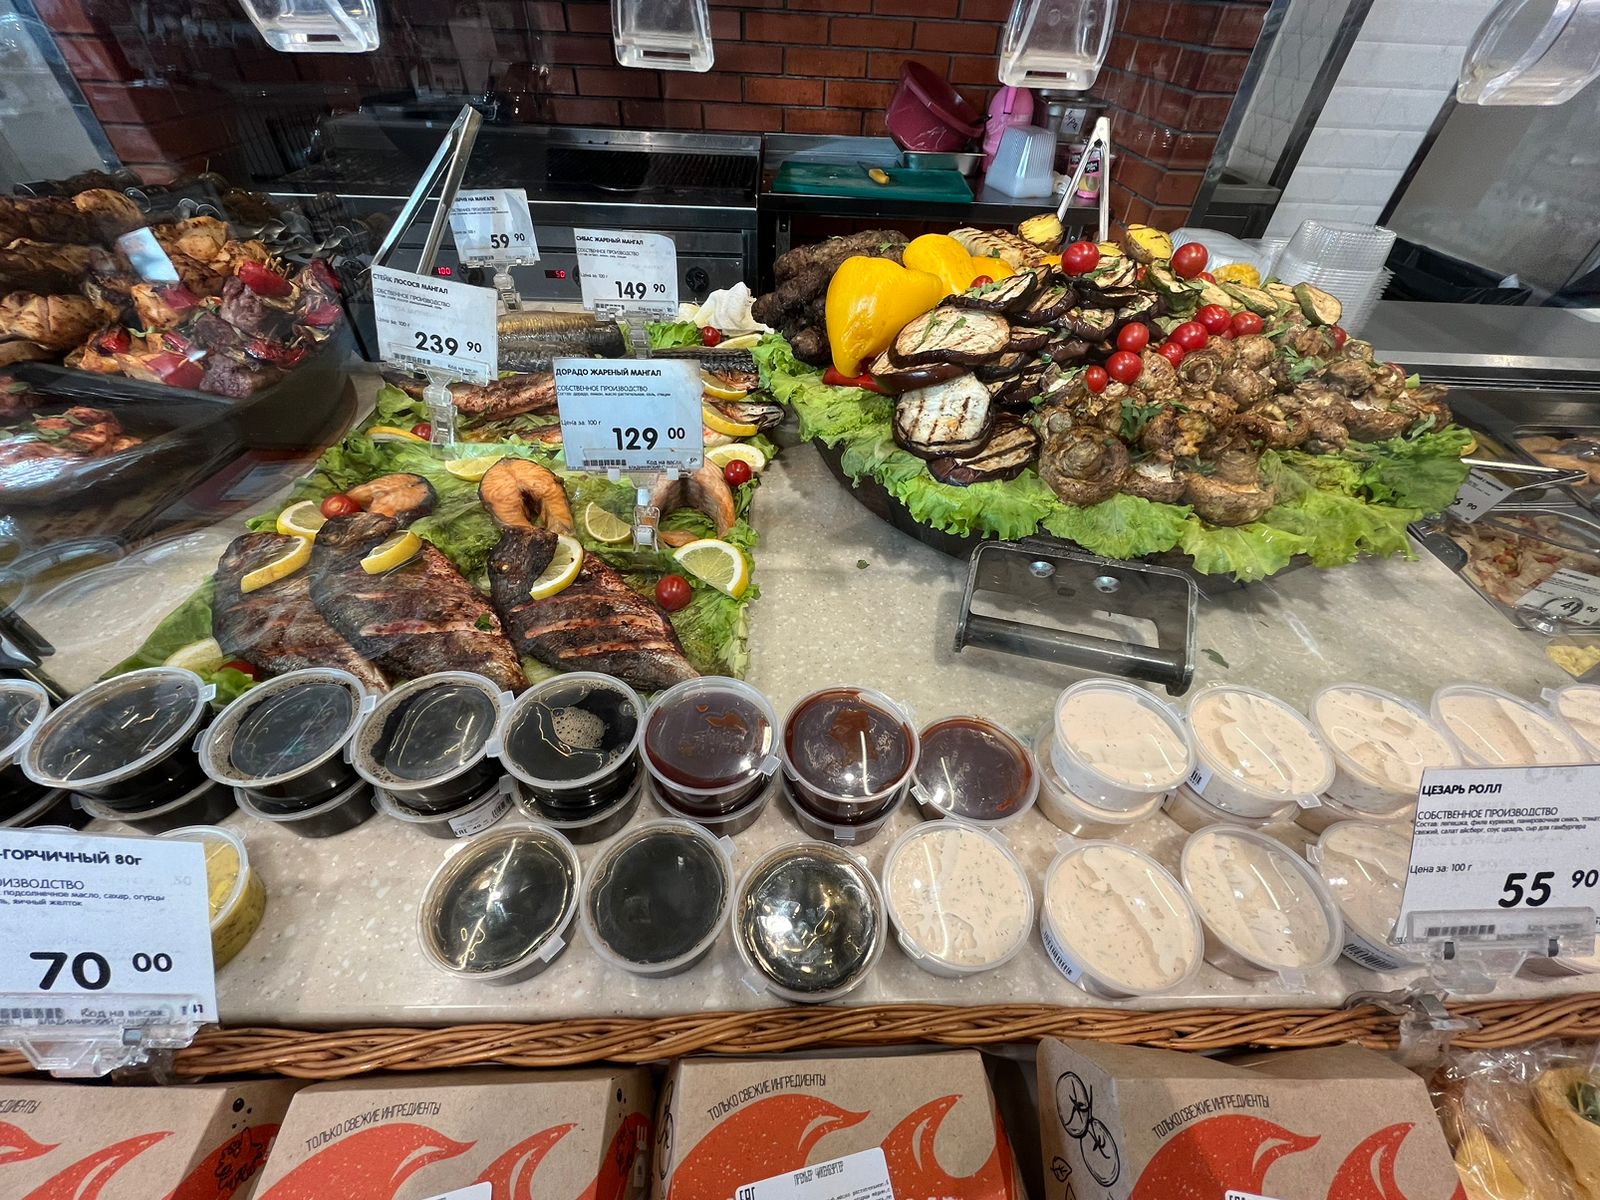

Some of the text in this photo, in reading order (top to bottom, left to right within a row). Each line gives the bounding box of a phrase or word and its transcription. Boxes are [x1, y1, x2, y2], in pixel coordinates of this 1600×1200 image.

[490, 233, 510, 249] 59
[514, 232, 526, 242] 90
[437, 267, 452, 276] 100
[373, 274, 449, 295] СТЕЙК ЛОСОСЯ МАНГАЛ
[615, 281, 647, 300] 149
[653, 283, 666, 293] 90
[415, 331, 459, 356] 239
[466, 341, 482, 353] 90
[556, 368, 662, 377] ДОРАДО ЖАРЕНЫЙ МАНГАЛ
[612, 427, 659, 451] 129
[668, 427, 685, 440] 00
[1422, 784, 1502, 796] ЦЕЗАРЬ РОЛЛ
[1418, 807, 1558, 820] СОБСТВЕННОЕ ПРОИЗВОДСТВО
[0, 849, 142, 866] -ГОРЧИЧНЫЙ 80г
[1410, 864, 1434, 873] Цена
[1436, 864, 1448, 872] за:
[1451, 863, 1466, 871] 100
[1571, 870, 1599, 888] 90
[1498, 871, 1555, 908] 55
[29, 952, 111, 990] 70
[132, 953, 172, 972] 00
[80, 1007, 106, 1018] Код
[707, 1074, 826, 1121] ТОЛЬКО СВЕЖИЕ ИНГРЕДИЕНТЫ
[1152, 1094, 1270, 1139] ТОЛЬКО СВЕЖИЕ ИНГРЕДИЕНТЫ
[305, 1102, 442, 1151] ТОЛЬКО СВЕЖИЕ ИНГРЕДИЕНТЫ
